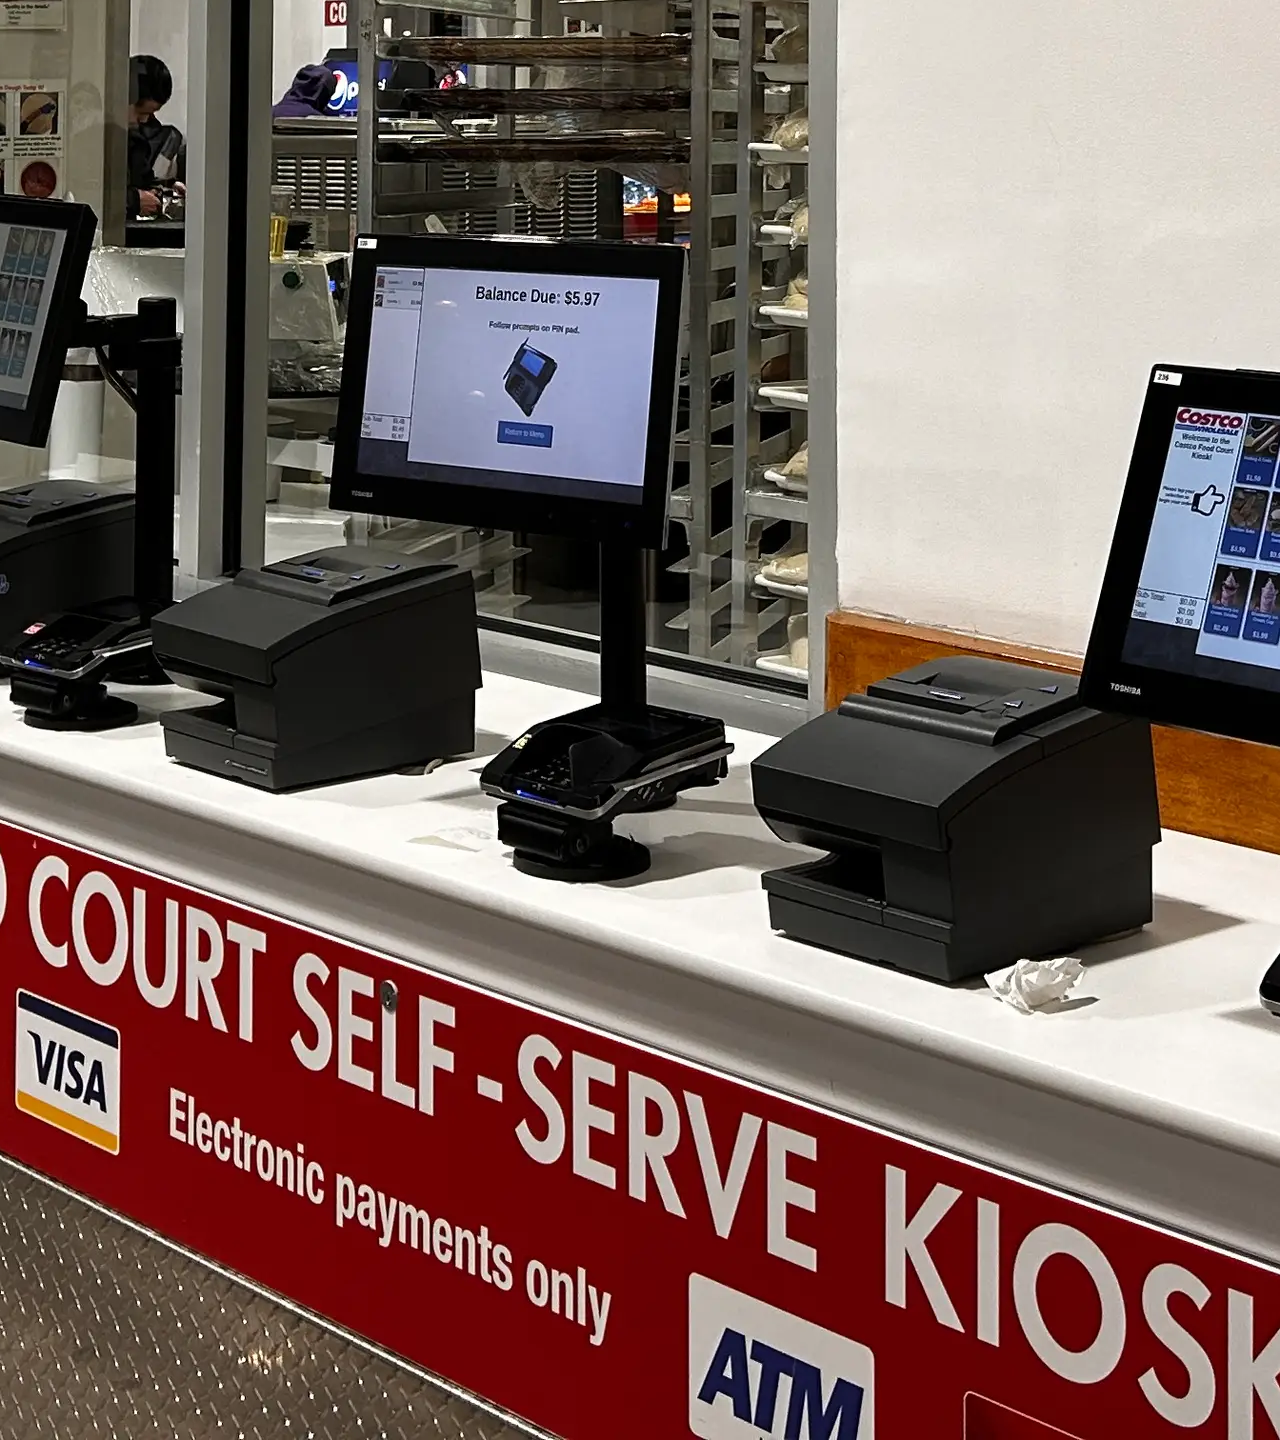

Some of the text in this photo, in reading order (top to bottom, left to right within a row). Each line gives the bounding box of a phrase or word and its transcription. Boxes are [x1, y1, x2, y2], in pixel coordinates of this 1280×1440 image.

[476, 286, 600, 306] Balance Due: $5.97
[489, 321, 510, 329] Follow
[512, 322, 539, 332] prompts
[552, 325, 563, 333] PIN
[1176, 408, 1243, 429] COSTCO
[1195, 426, 1239, 436] WHOLESALE
[1110, 682, 1141, 695] TOSHIBA
[29, 855, 267, 1044] COURT
[27, 1029, 107, 1113] VISA
[169, 1088, 611, 1347] Electronic payments only
[697, 1327, 864, 1440] ATM
